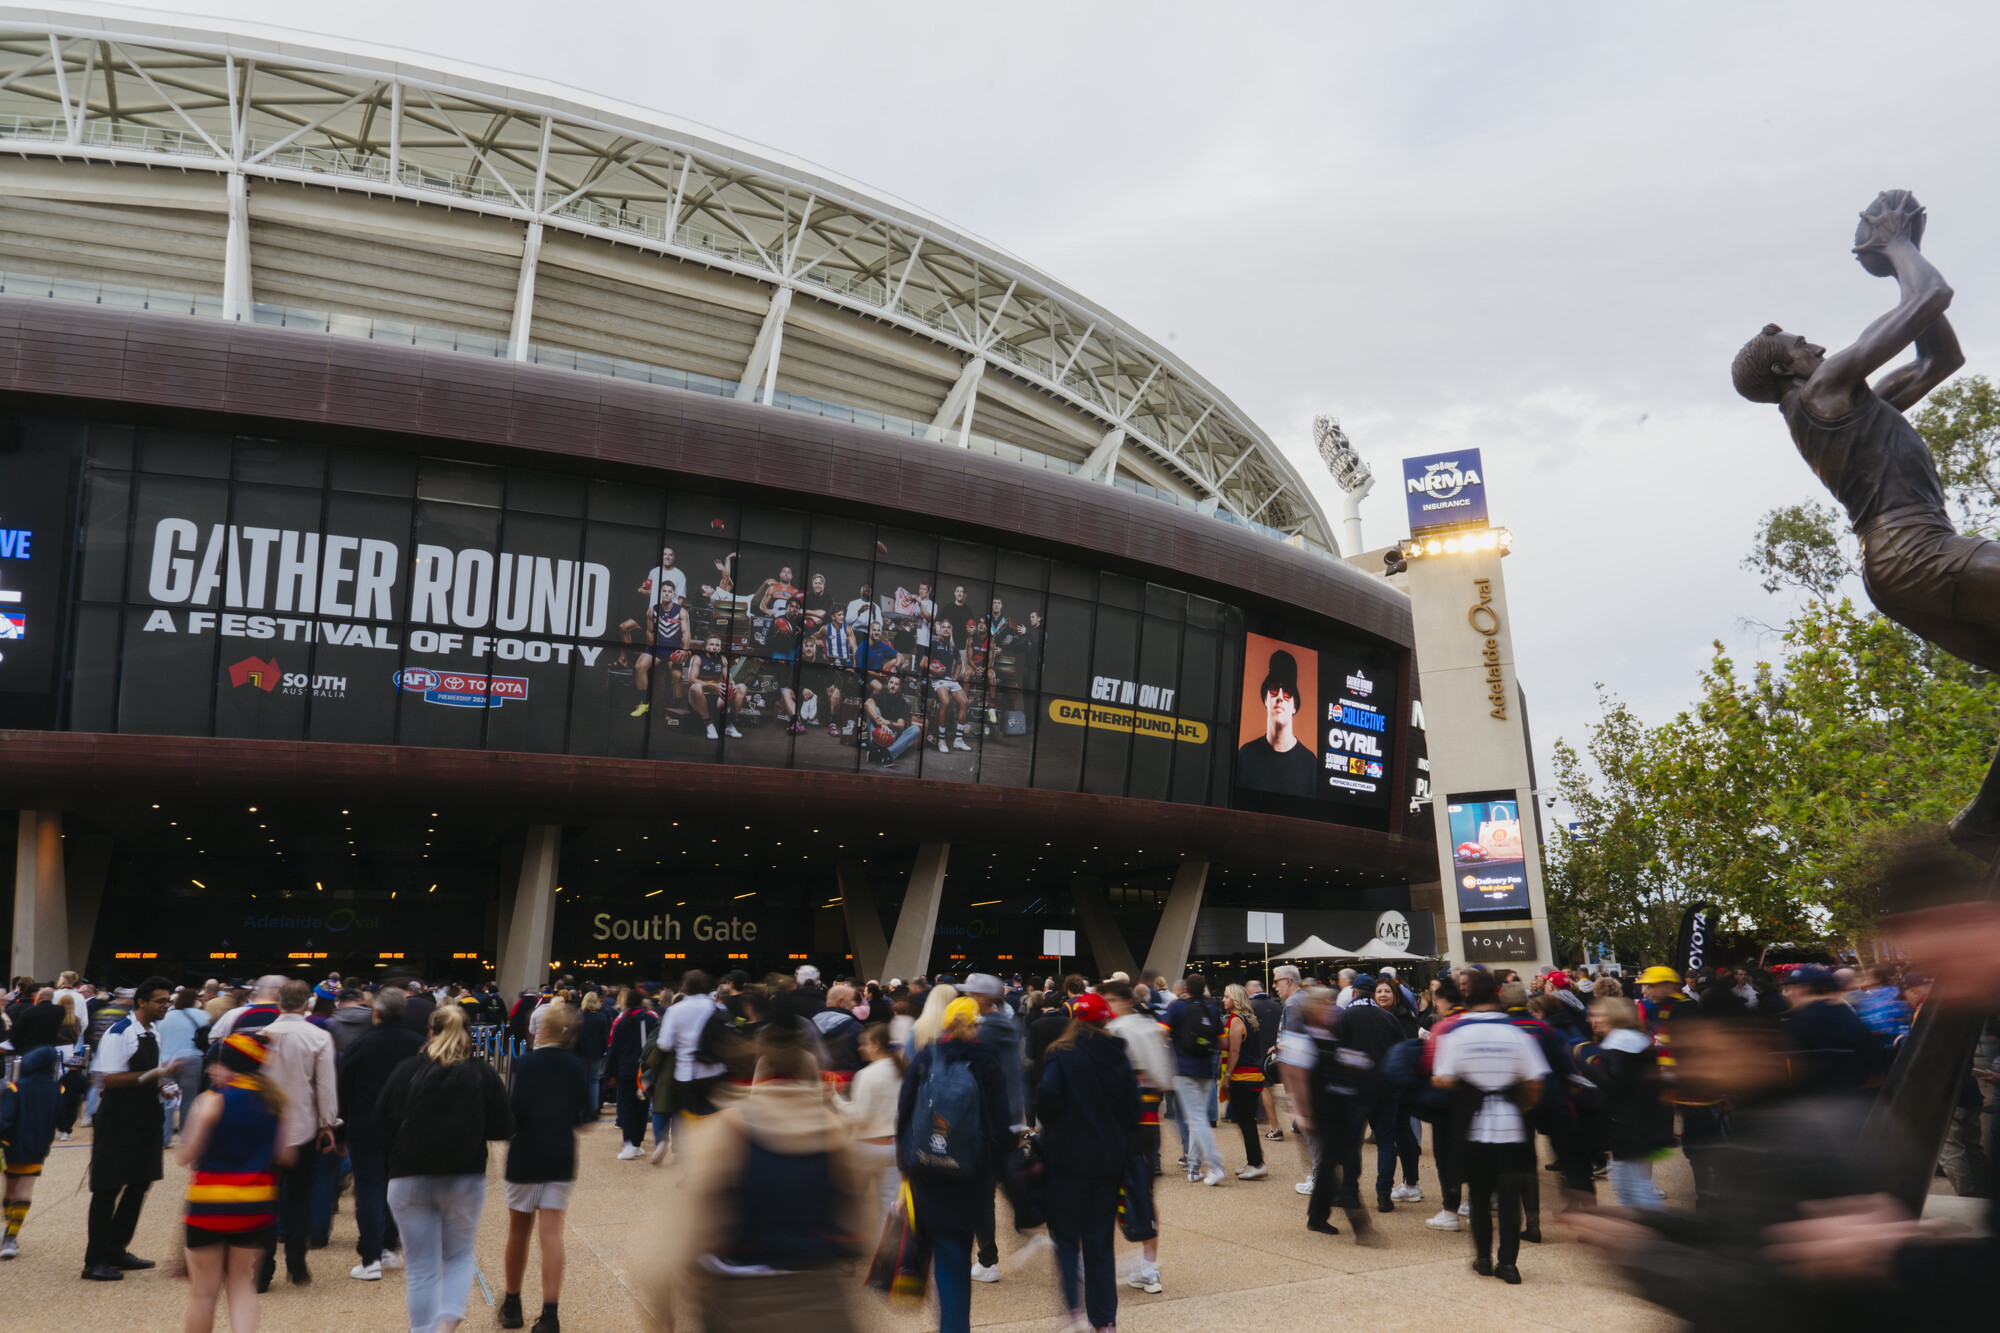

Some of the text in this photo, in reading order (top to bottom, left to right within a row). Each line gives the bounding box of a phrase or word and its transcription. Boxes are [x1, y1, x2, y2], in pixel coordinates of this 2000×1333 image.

[1407, 469, 1481, 494] NRMA
[1423, 498, 1471, 511] INSURANCE
[148, 517, 611, 638] GATHER ROUND
[142, 609, 604, 667] A FESTIVAL OF FOOTY
[1468, 577, 1507, 720] Adelaide Oval
[282, 672, 347, 691] SOUTH
[403, 672, 437, 687] AFL
[468, 679, 523, 694] TOYOTA
[437, 693, 472, 702] PREMIERSHIP
[1091, 675, 1175, 711] GET IN ON IT
[1059, 705, 1200, 738] GATHERROUND.AFL
[1342, 705, 1386, 733] COLLECTIVE
[1328, 728, 1382, 757] CYRIL
[1476, 877, 1507, 886] Delivery
[1507, 876, 1522, 884] Fee
[1493, 884, 1514, 892] played
[242, 907, 380, 932] Adelaide Oval
[592, 912, 757, 942] South Gate
[1379, 919, 1409, 939] CAFÉ
[1688, 912, 1707, 971] OYOTA
